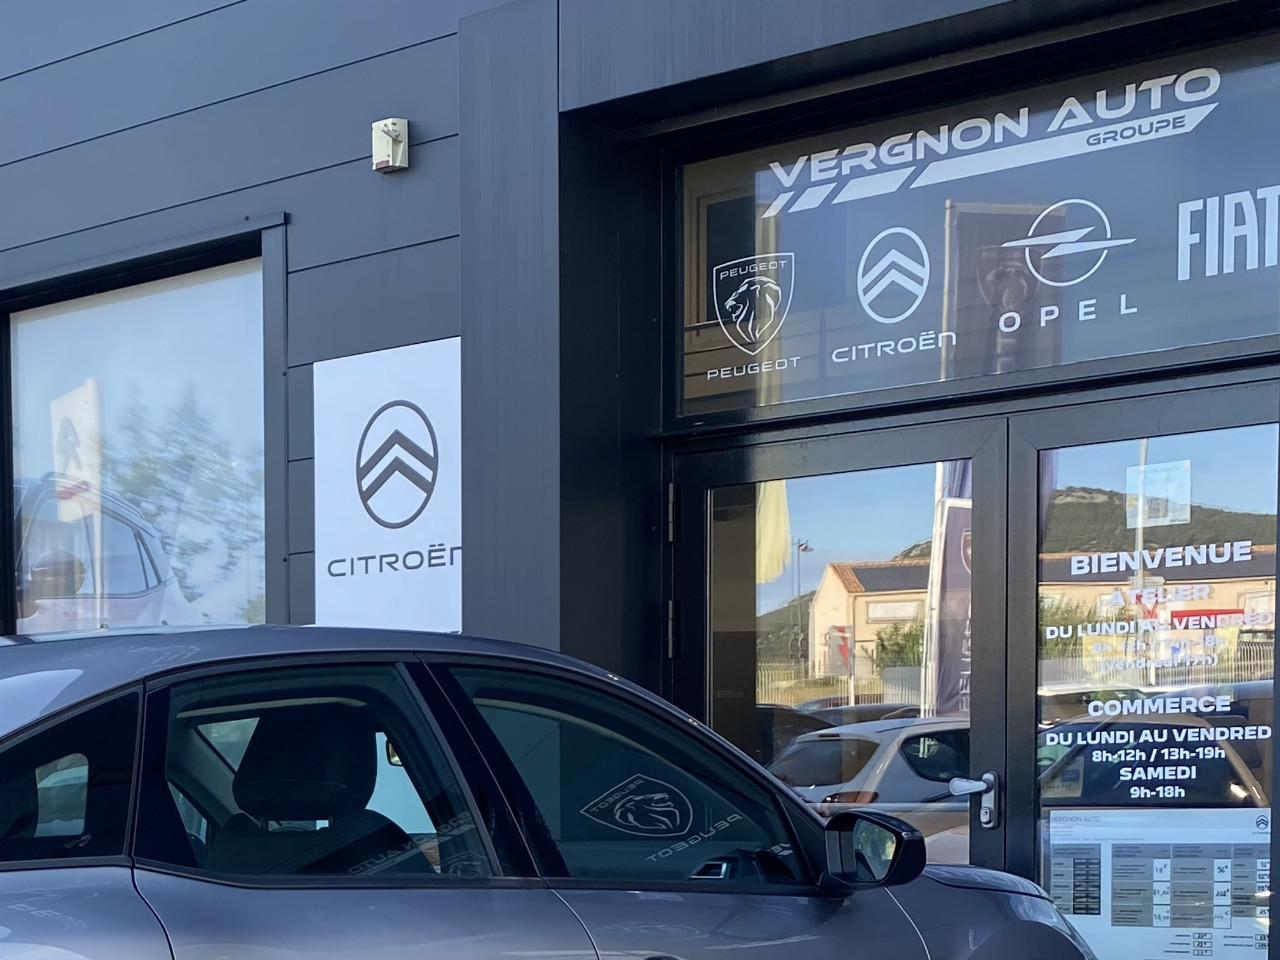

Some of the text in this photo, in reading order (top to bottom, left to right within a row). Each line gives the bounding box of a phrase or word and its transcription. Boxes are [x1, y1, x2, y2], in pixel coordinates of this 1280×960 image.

[768, 67, 1222, 188] VERGNON AUTO
[1086, 115, 1187, 147] GROUPE
[1178, 184, 1280, 281] FIAT
[720, 259, 787, 280] PEUGEOT
[999, 293, 1138, 332] OPEL
[706, 356, 801, 380] PEUGEOT
[1070, 541, 1252, 575] BIENVENUE
[1108, 584, 1211, 608] ATELIER
[1046, 625, 1073, 640] DU
[1078, 621, 1135, 637] LUNDI
[1088, 695, 1231, 717] COMMERCE
[1046, 732, 1073, 746] DU
[1078, 730, 1135, 745] LUNDI
[1140, 729, 1168, 743] AU
[1092, 747, 1226, 762] 8h-12h / 13h-19h
[1120, 766, 1196, 781] SAMEDI
[1130, 787, 1186, 799] 9h-18h
